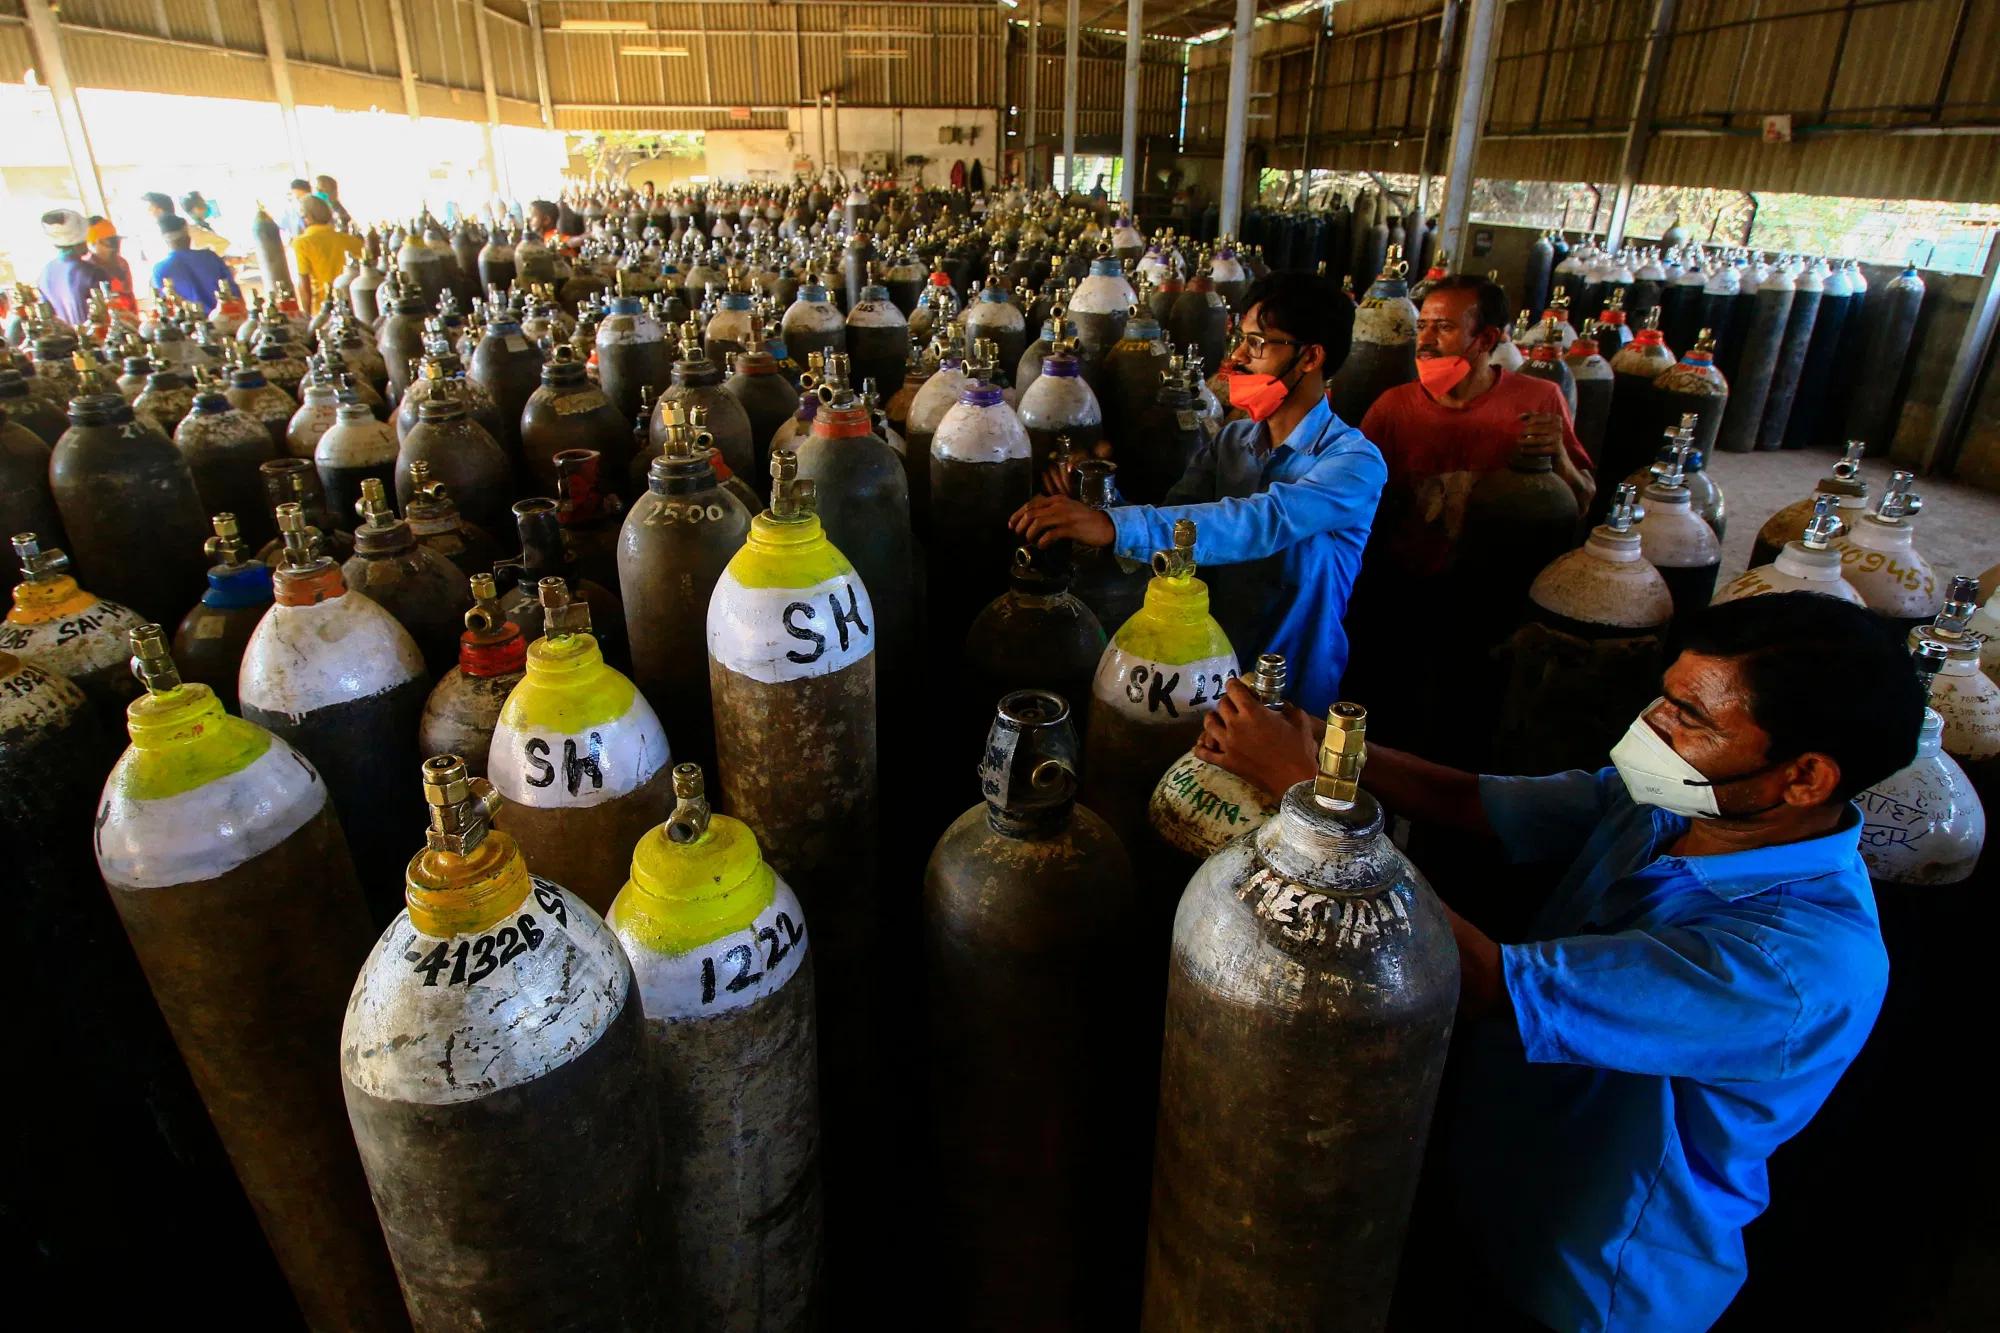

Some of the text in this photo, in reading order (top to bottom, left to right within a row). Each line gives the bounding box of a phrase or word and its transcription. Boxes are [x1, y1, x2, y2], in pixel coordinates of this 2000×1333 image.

[643, 501, 724, 526] 2500
[1126, 665, 1179, 718] SK
[701, 911, 804, 1005] 1222
